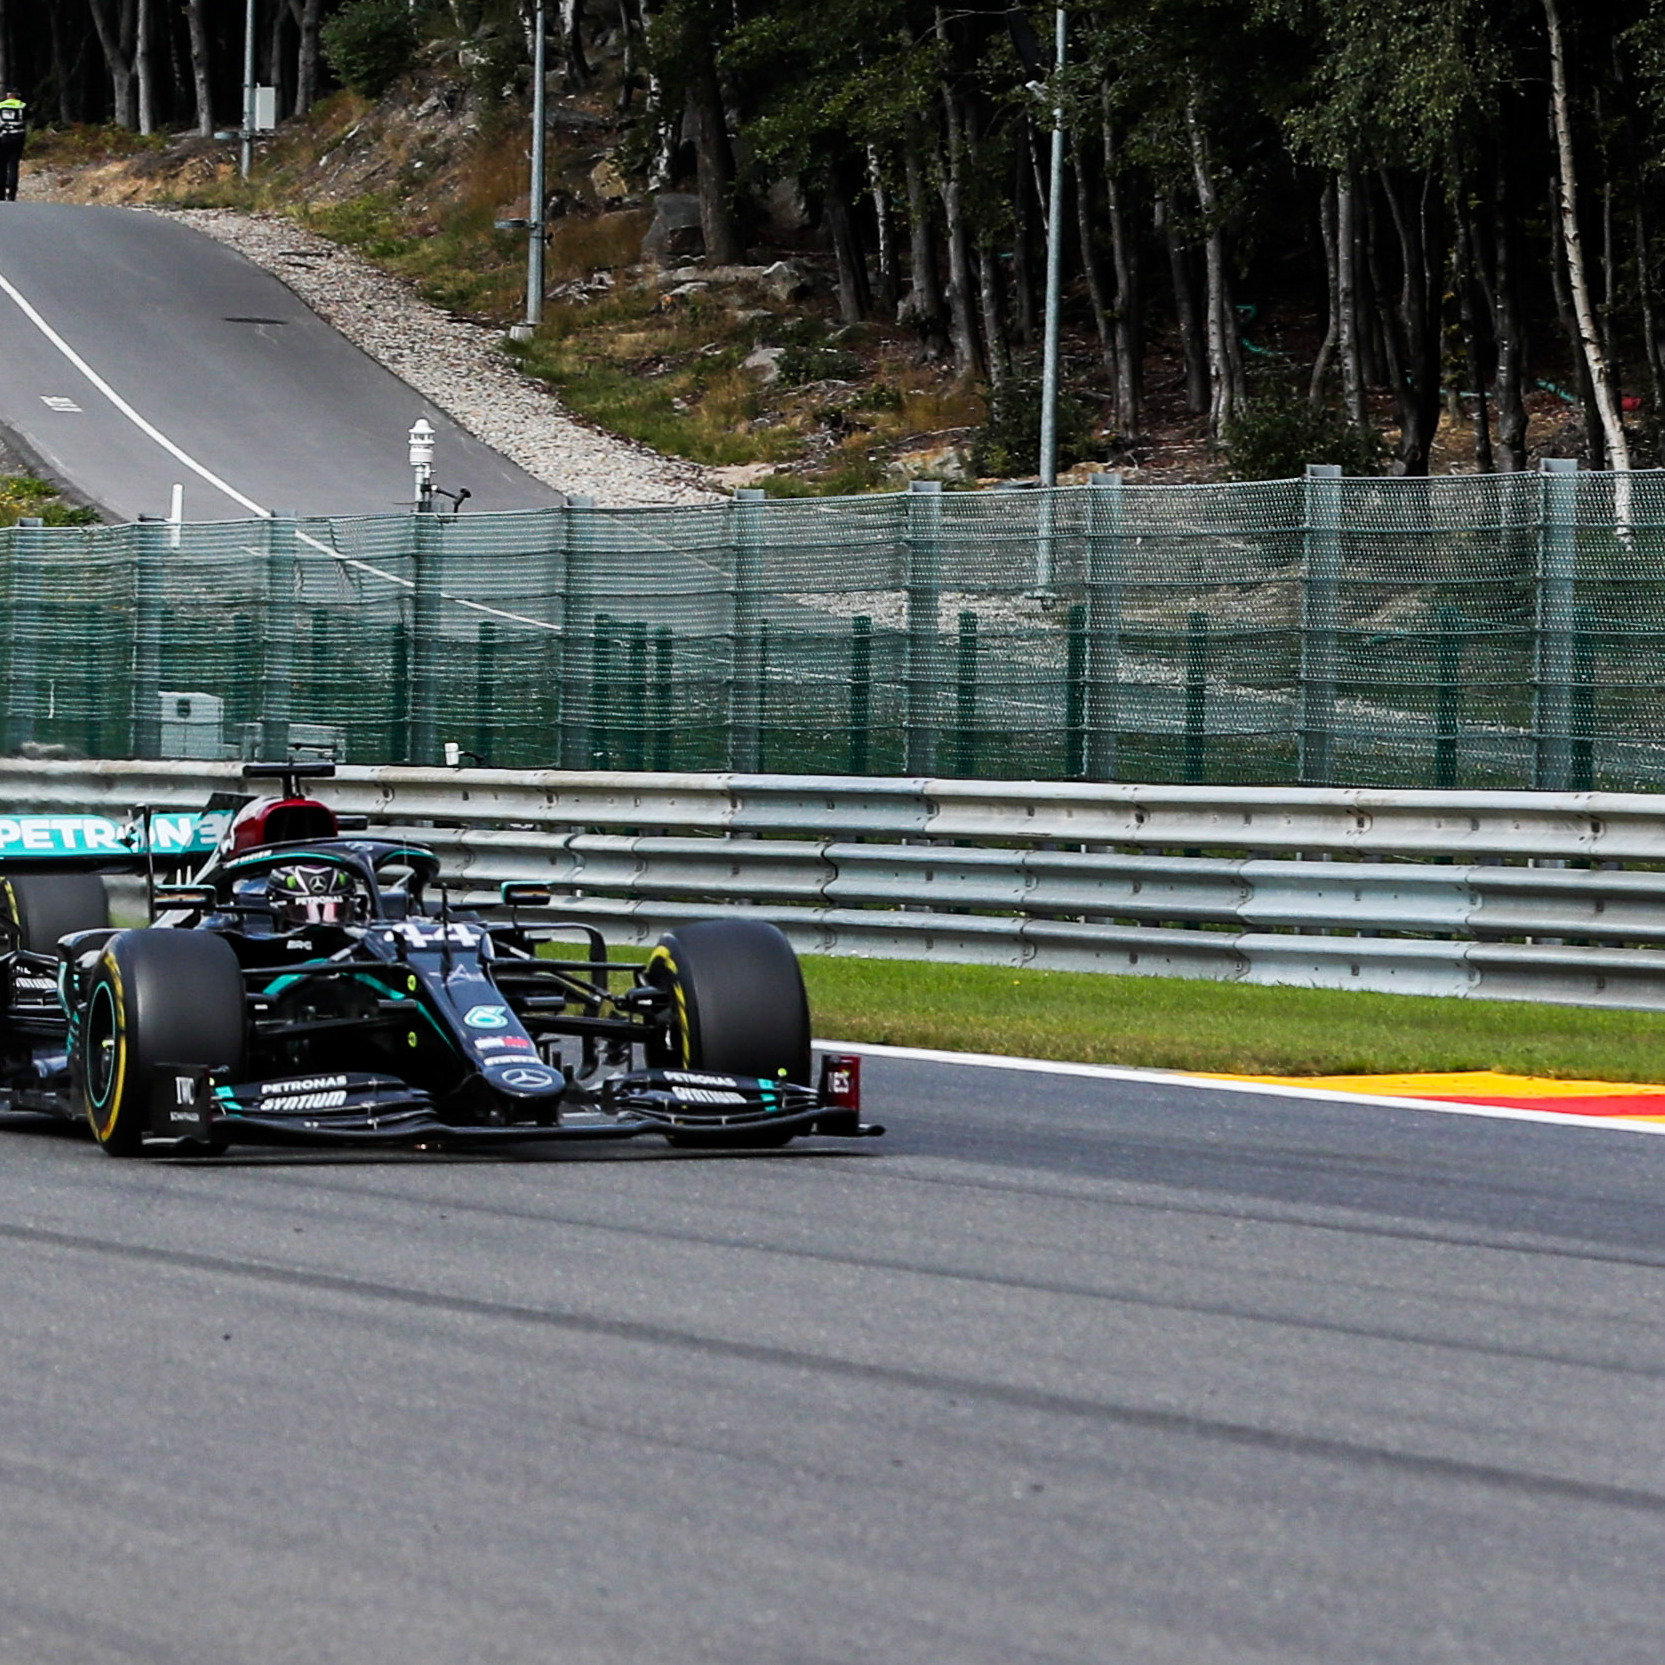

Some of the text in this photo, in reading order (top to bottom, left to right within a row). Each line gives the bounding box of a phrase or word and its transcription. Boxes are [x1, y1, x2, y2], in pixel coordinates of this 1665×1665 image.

[262, 1075, 347, 1095] PETRONAS
[662, 1070, 737, 1088] PETRONAS
[260, 1090, 348, 1111] SYNTIUM
